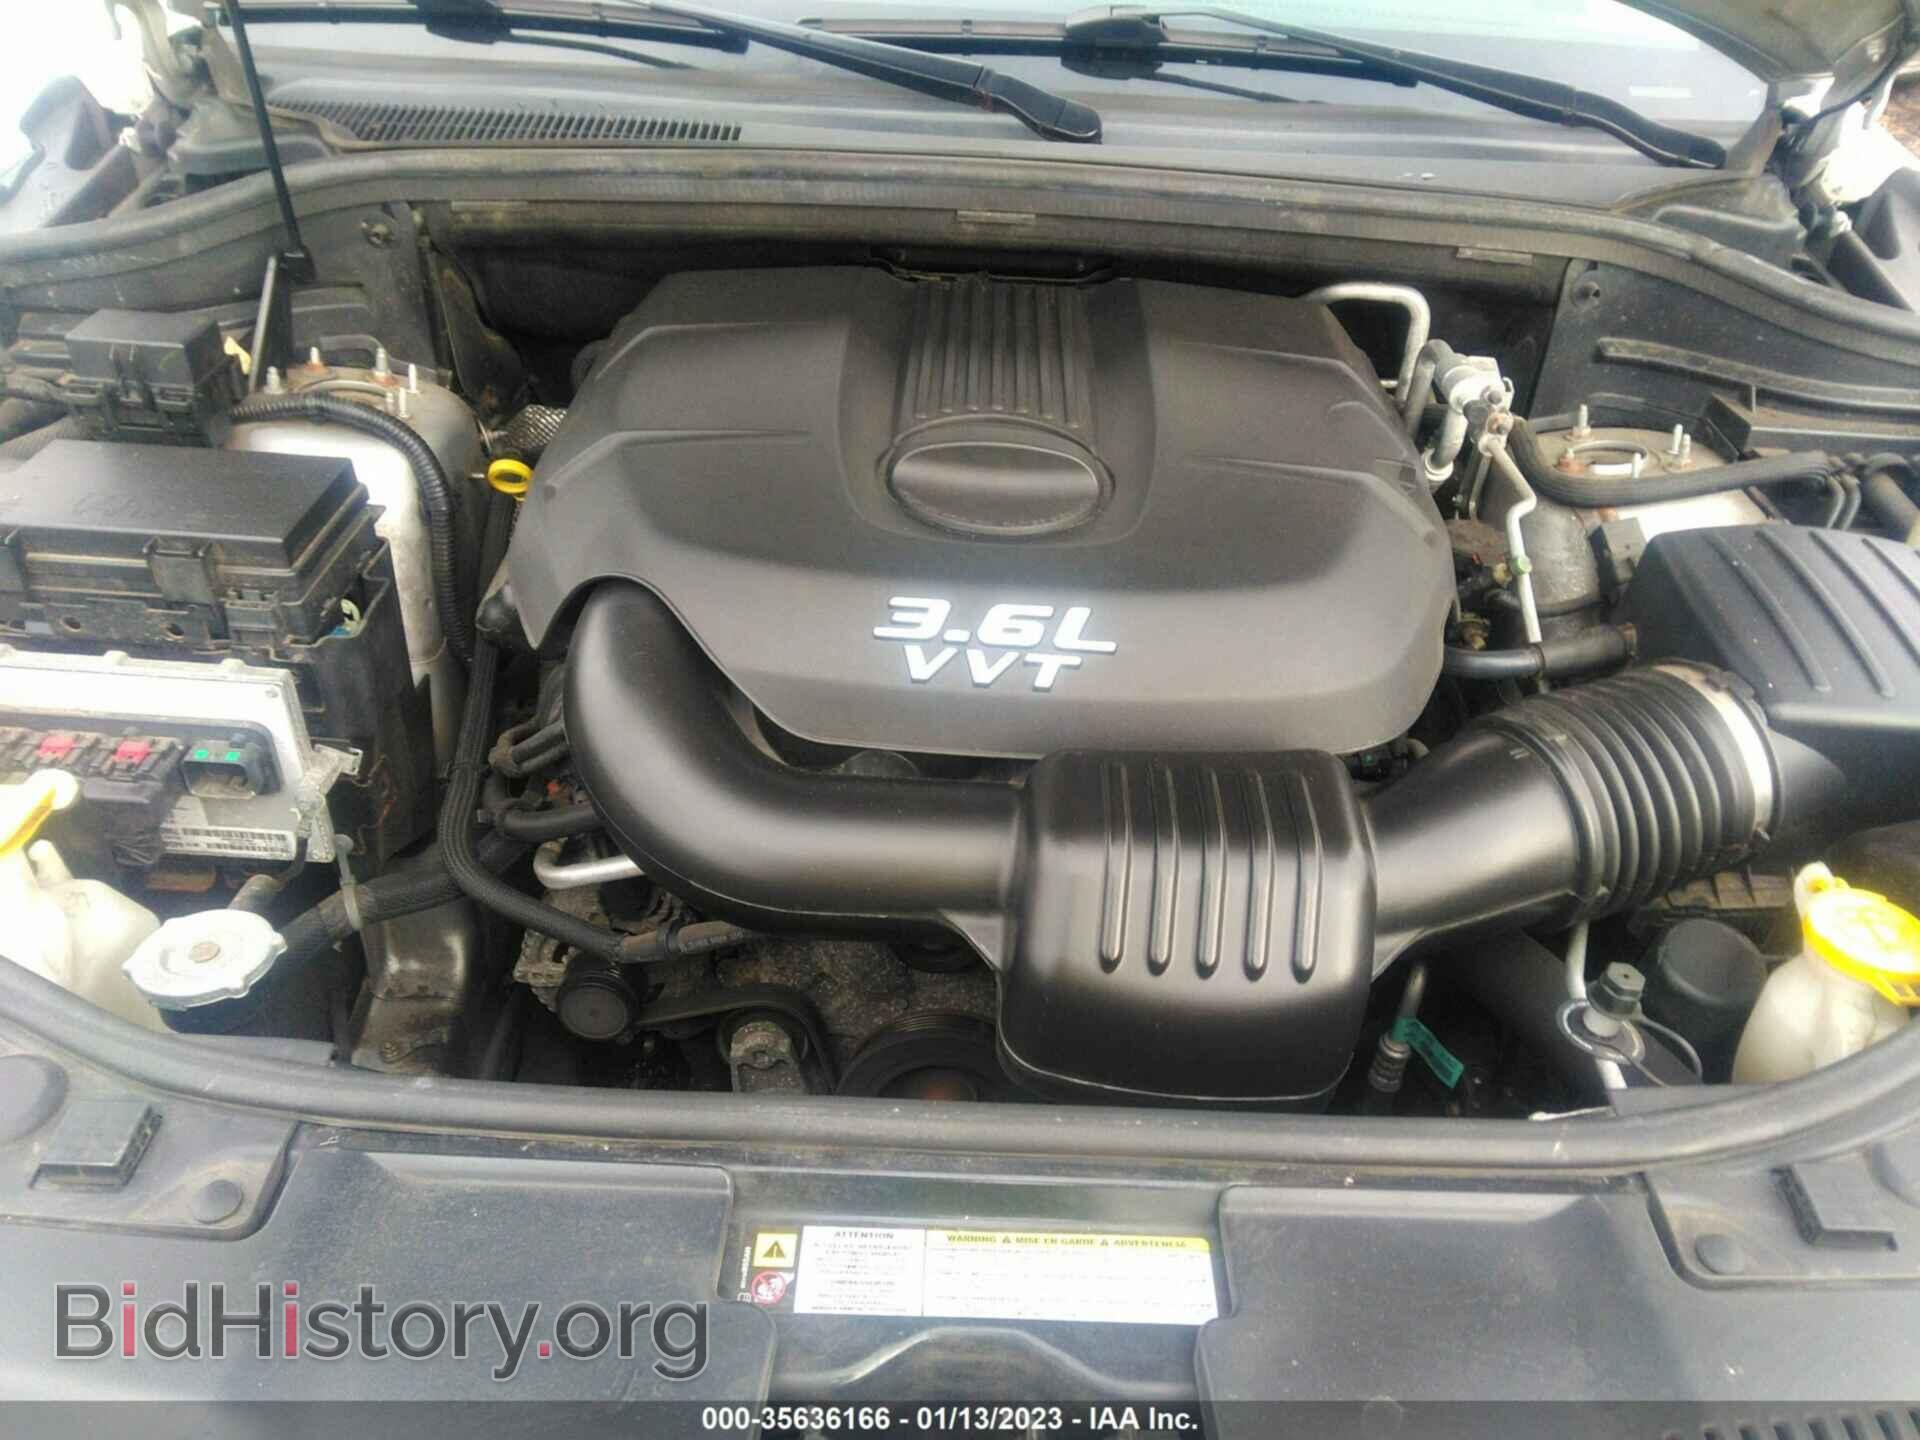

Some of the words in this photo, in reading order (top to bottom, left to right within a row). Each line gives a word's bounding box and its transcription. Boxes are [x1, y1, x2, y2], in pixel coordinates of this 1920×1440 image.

[873, 596, 1117, 654] 3.6L
[904, 645, 1083, 692] VVT
[833, 1230, 895, 1240] ATTENTION
[946, 1233, 997, 1243] WARNING
